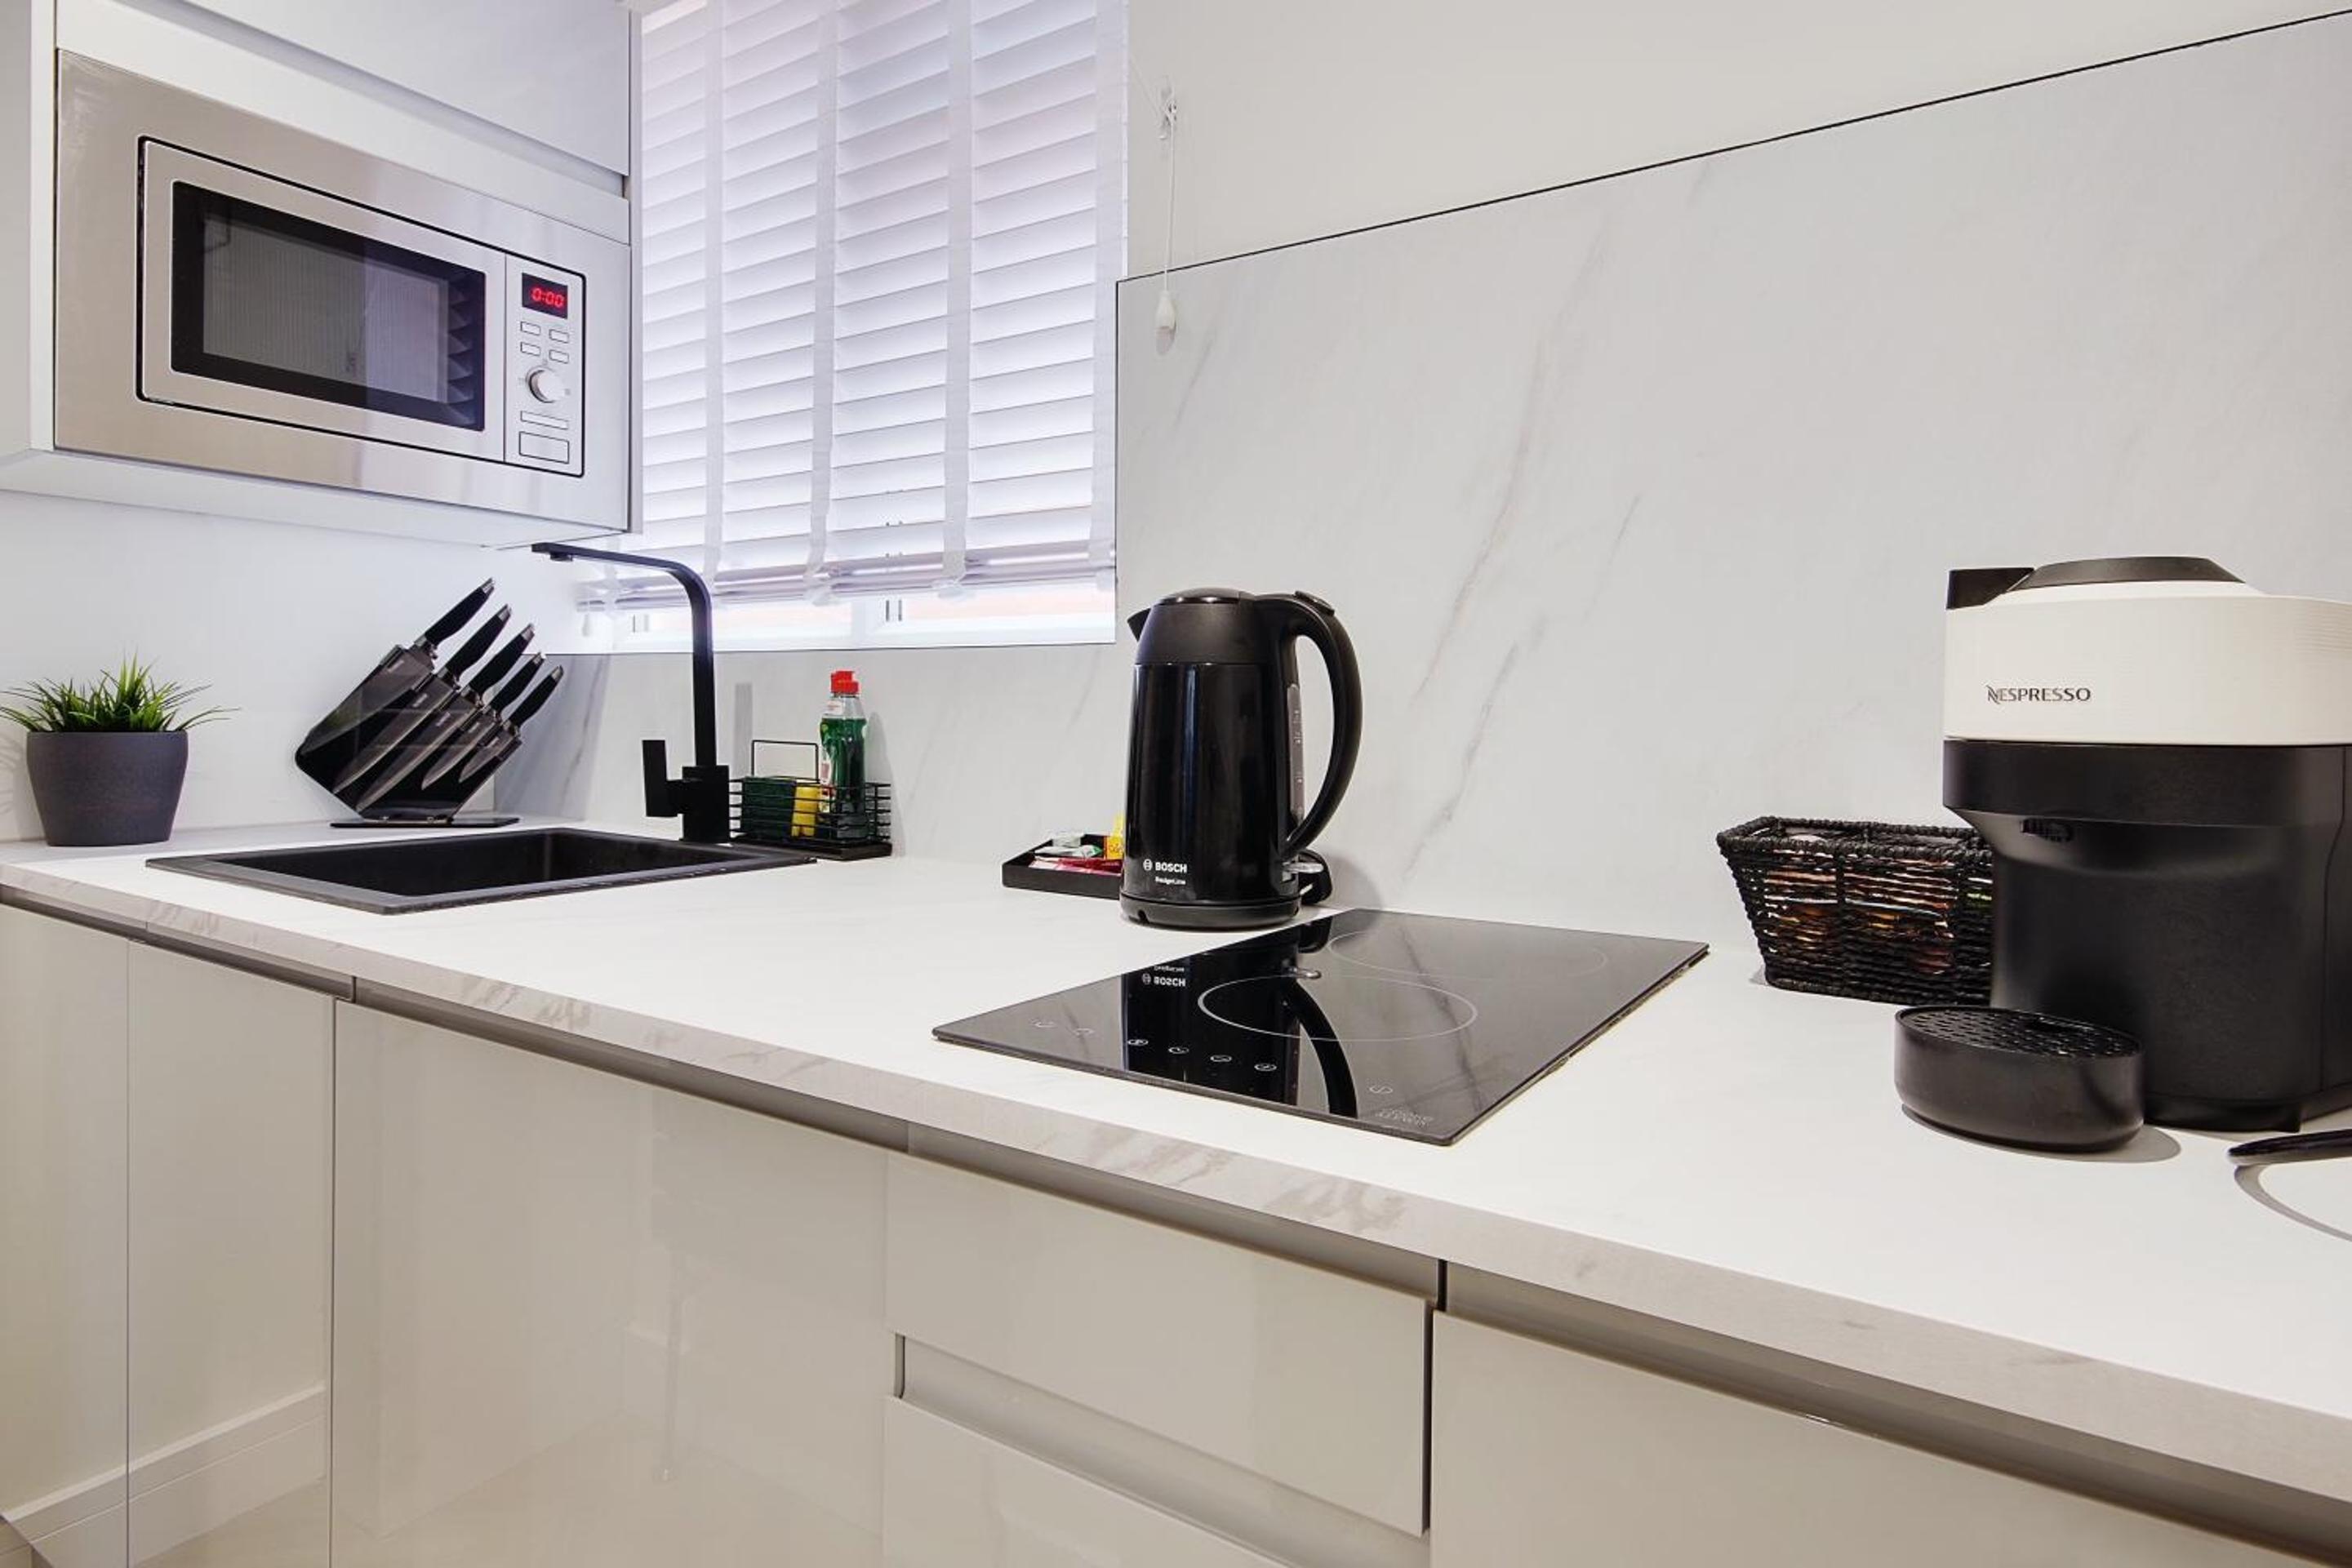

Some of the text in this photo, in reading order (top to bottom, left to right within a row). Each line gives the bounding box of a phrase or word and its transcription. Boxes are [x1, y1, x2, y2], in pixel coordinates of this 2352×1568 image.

[531, 287, 564, 308] 0:00
[1985, 685, 2091, 704] NESPRESSO
[1155, 861, 1187, 873] BOSCH
